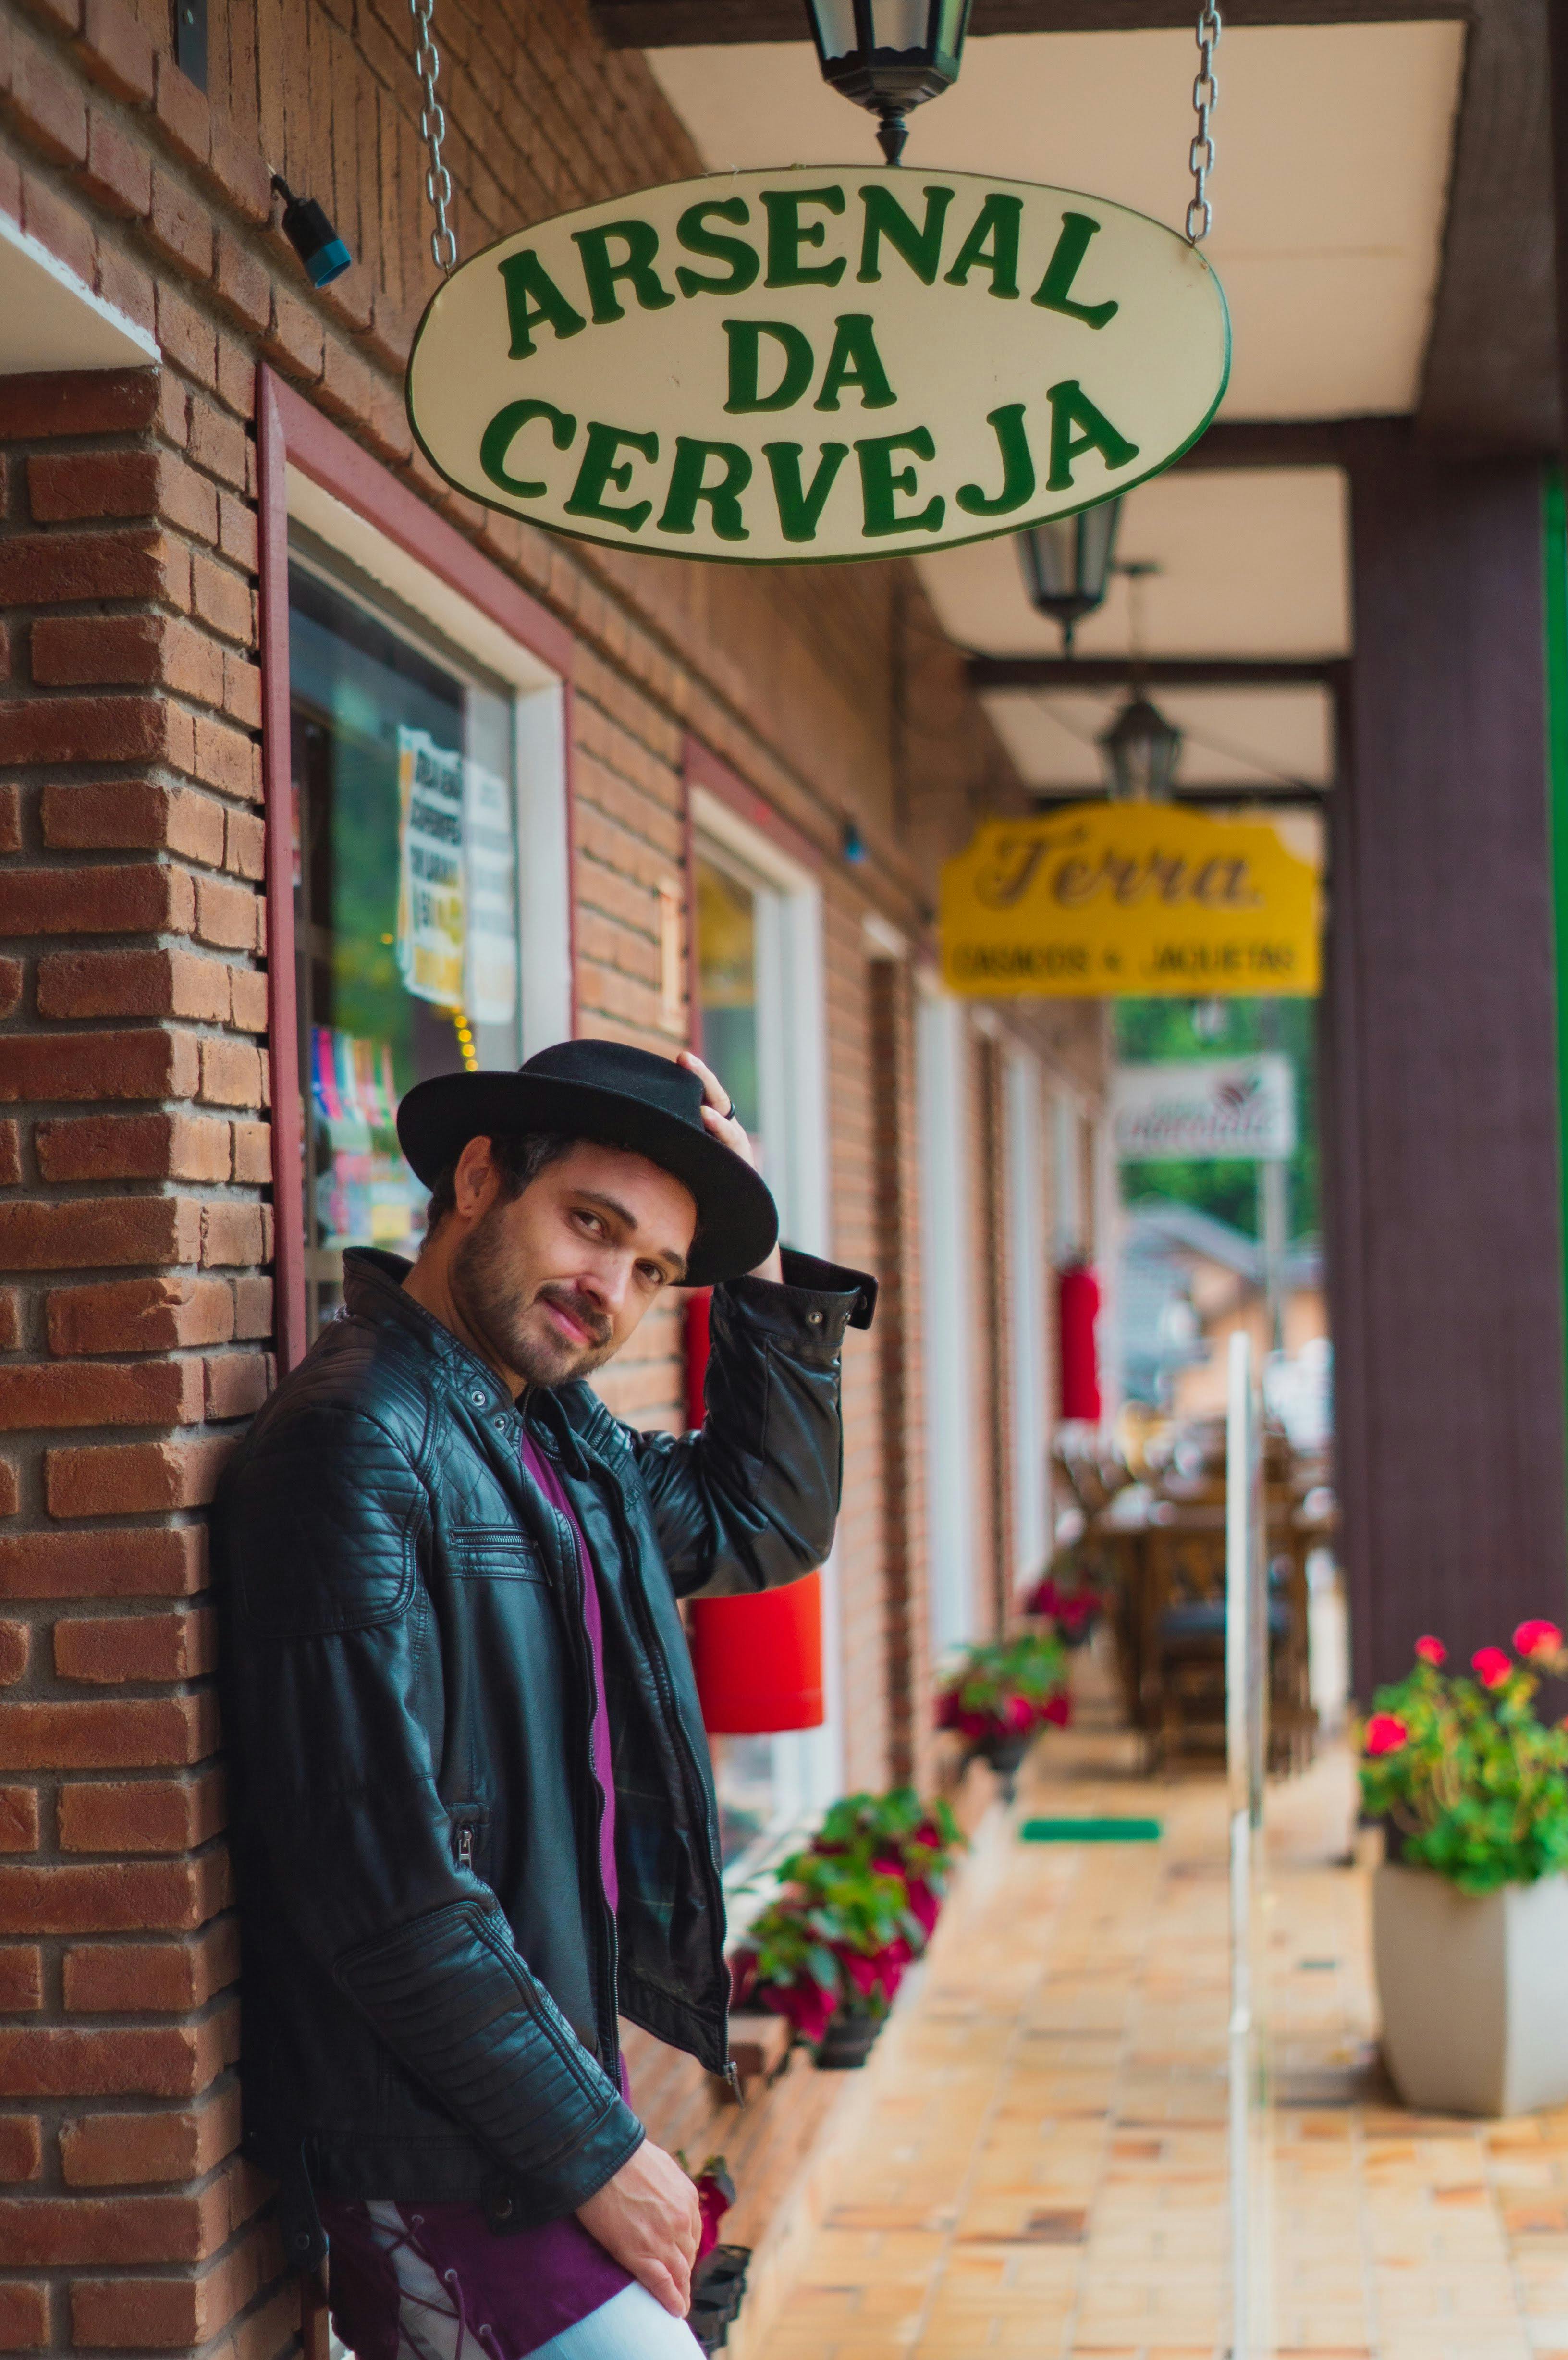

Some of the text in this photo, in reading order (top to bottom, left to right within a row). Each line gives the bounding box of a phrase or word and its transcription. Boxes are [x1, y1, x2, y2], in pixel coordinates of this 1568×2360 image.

[497, 184, 1119, 360] ARSENAL
[722, 313, 898, 415] DA
[479, 379, 1140, 541] CERVEJA
[975, 824, 1264, 910] Terra
